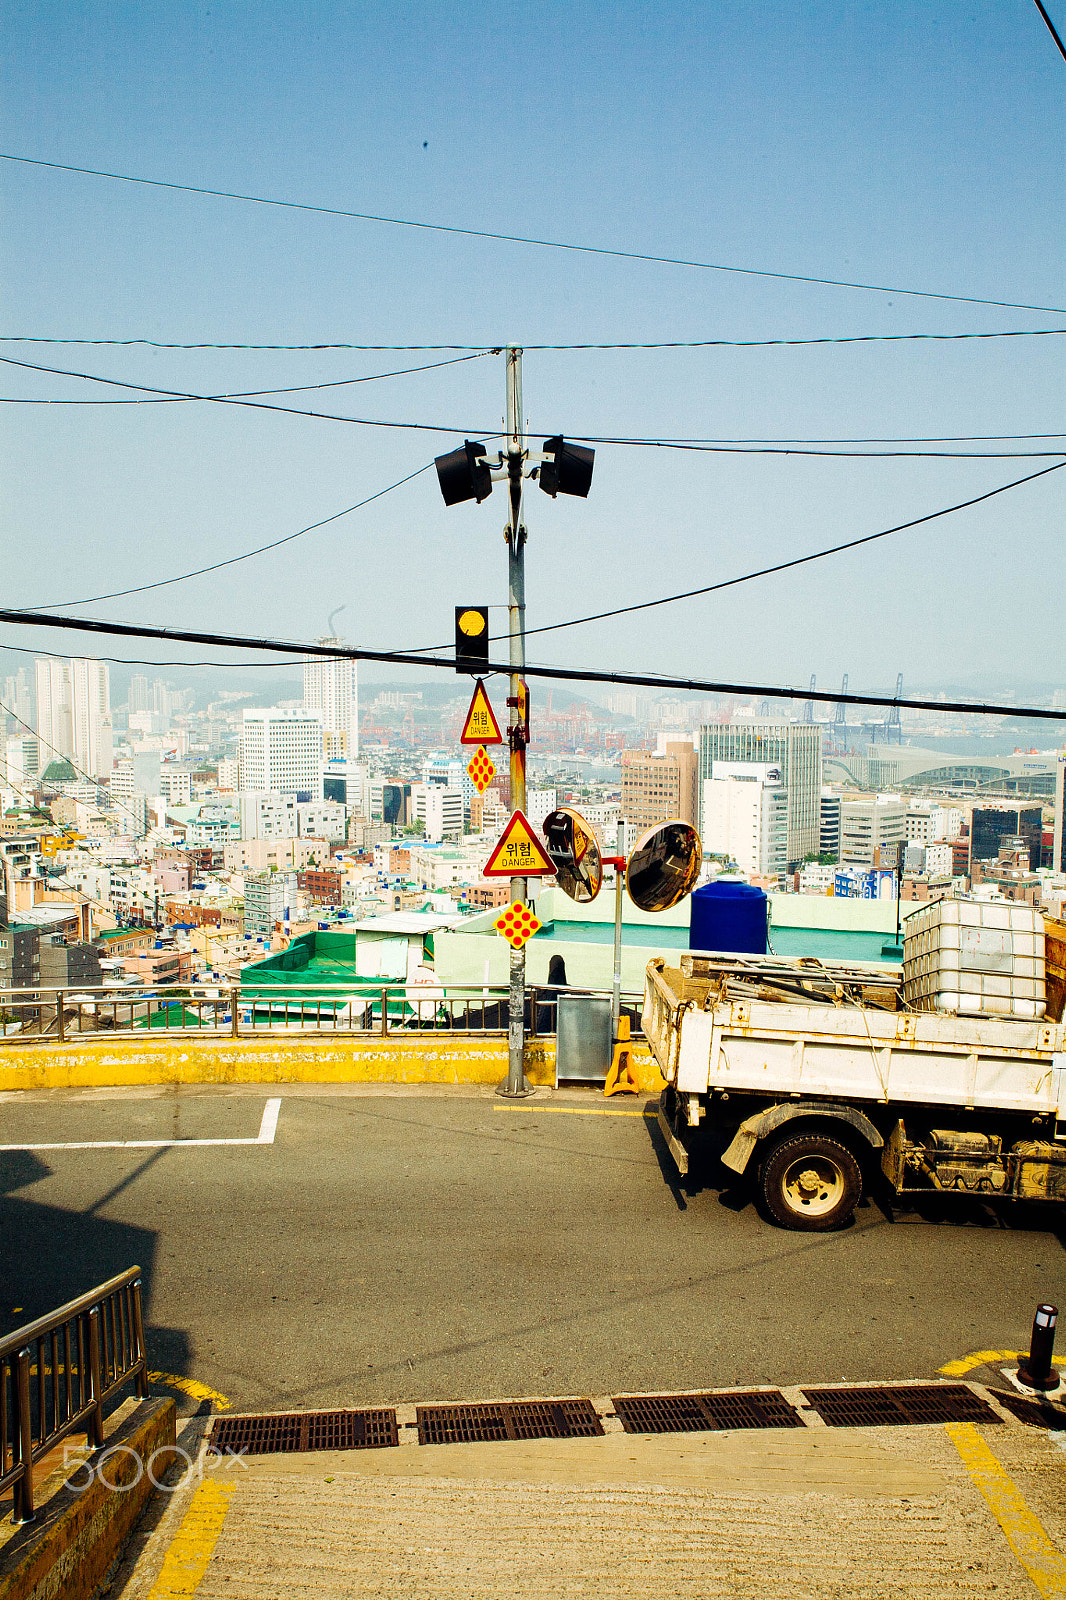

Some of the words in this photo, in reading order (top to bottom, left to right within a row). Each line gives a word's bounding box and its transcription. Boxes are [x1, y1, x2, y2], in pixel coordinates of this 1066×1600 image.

[473, 711, 488, 726] 위험
[470, 726, 490, 735] DANGER
[506, 842, 531, 857] 위험
[502, 857, 536, 867] DANGER
